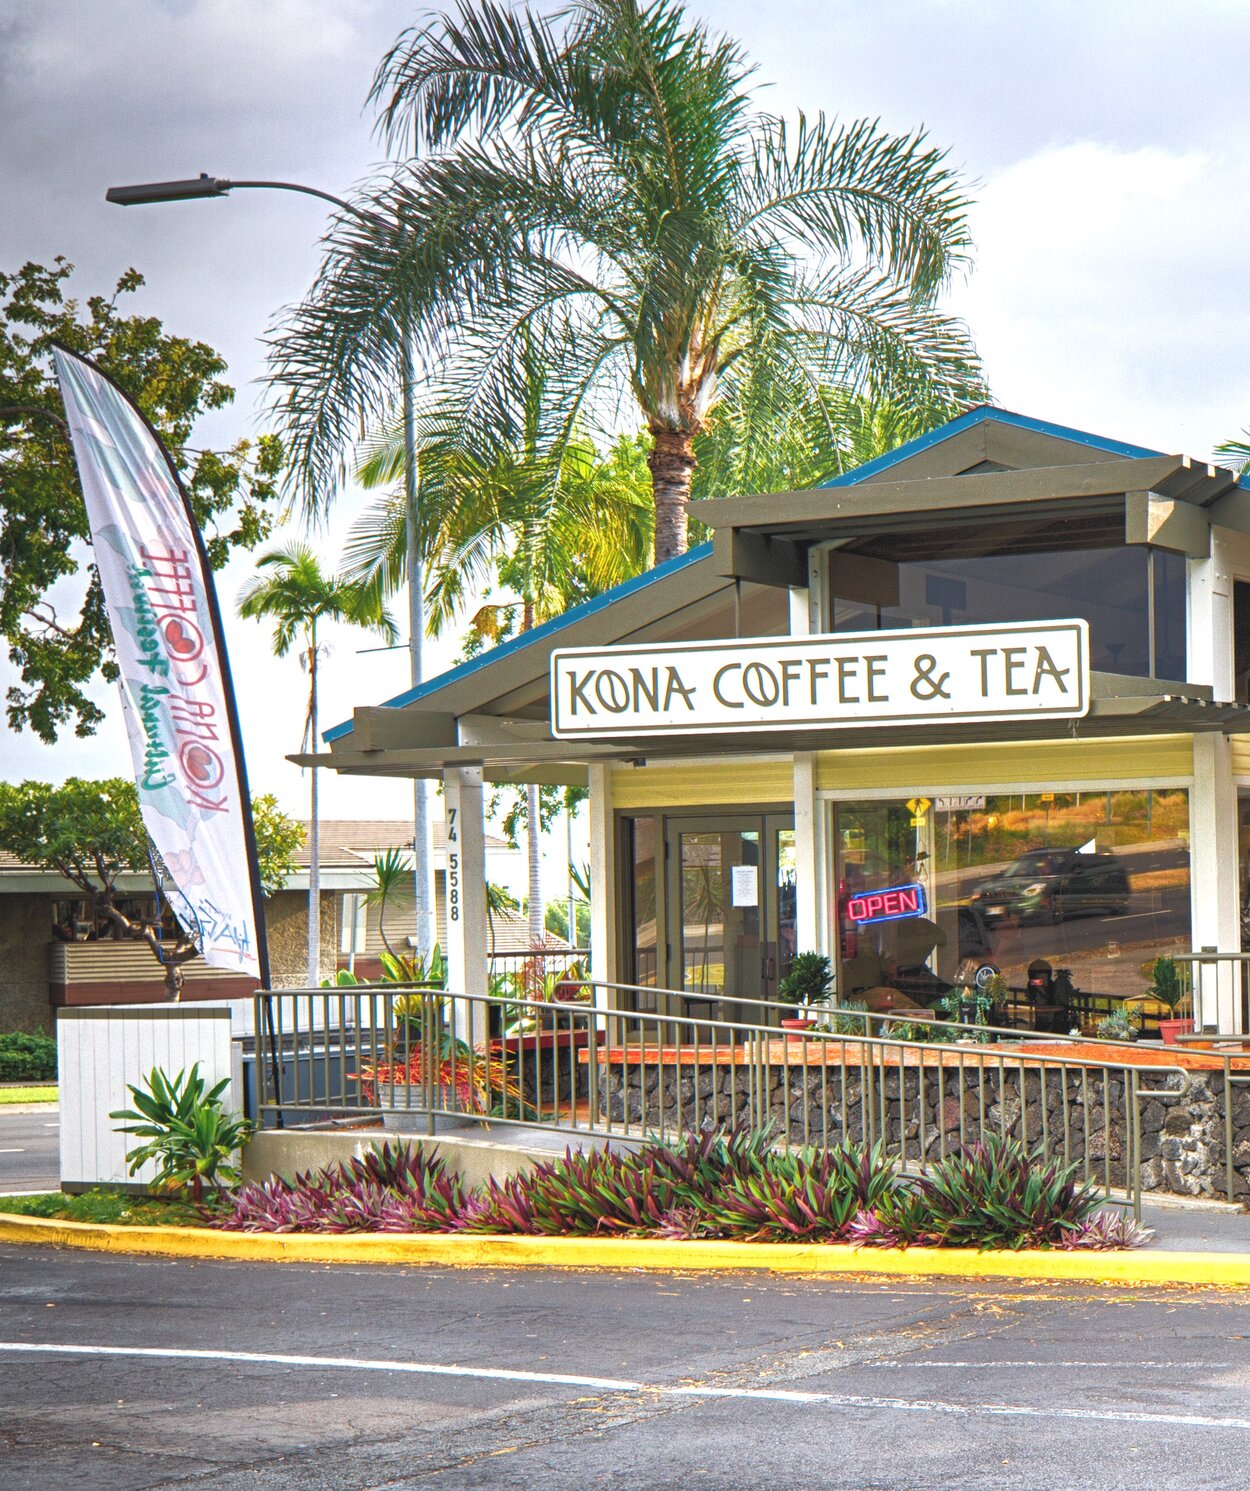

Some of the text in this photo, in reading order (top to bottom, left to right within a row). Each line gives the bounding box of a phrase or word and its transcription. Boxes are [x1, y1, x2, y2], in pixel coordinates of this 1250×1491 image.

[566, 646, 1070, 716] KONA COFFEE & TEA
[448, 809, 459, 921] 74 5588
[848, 889, 919, 921] OPEN
